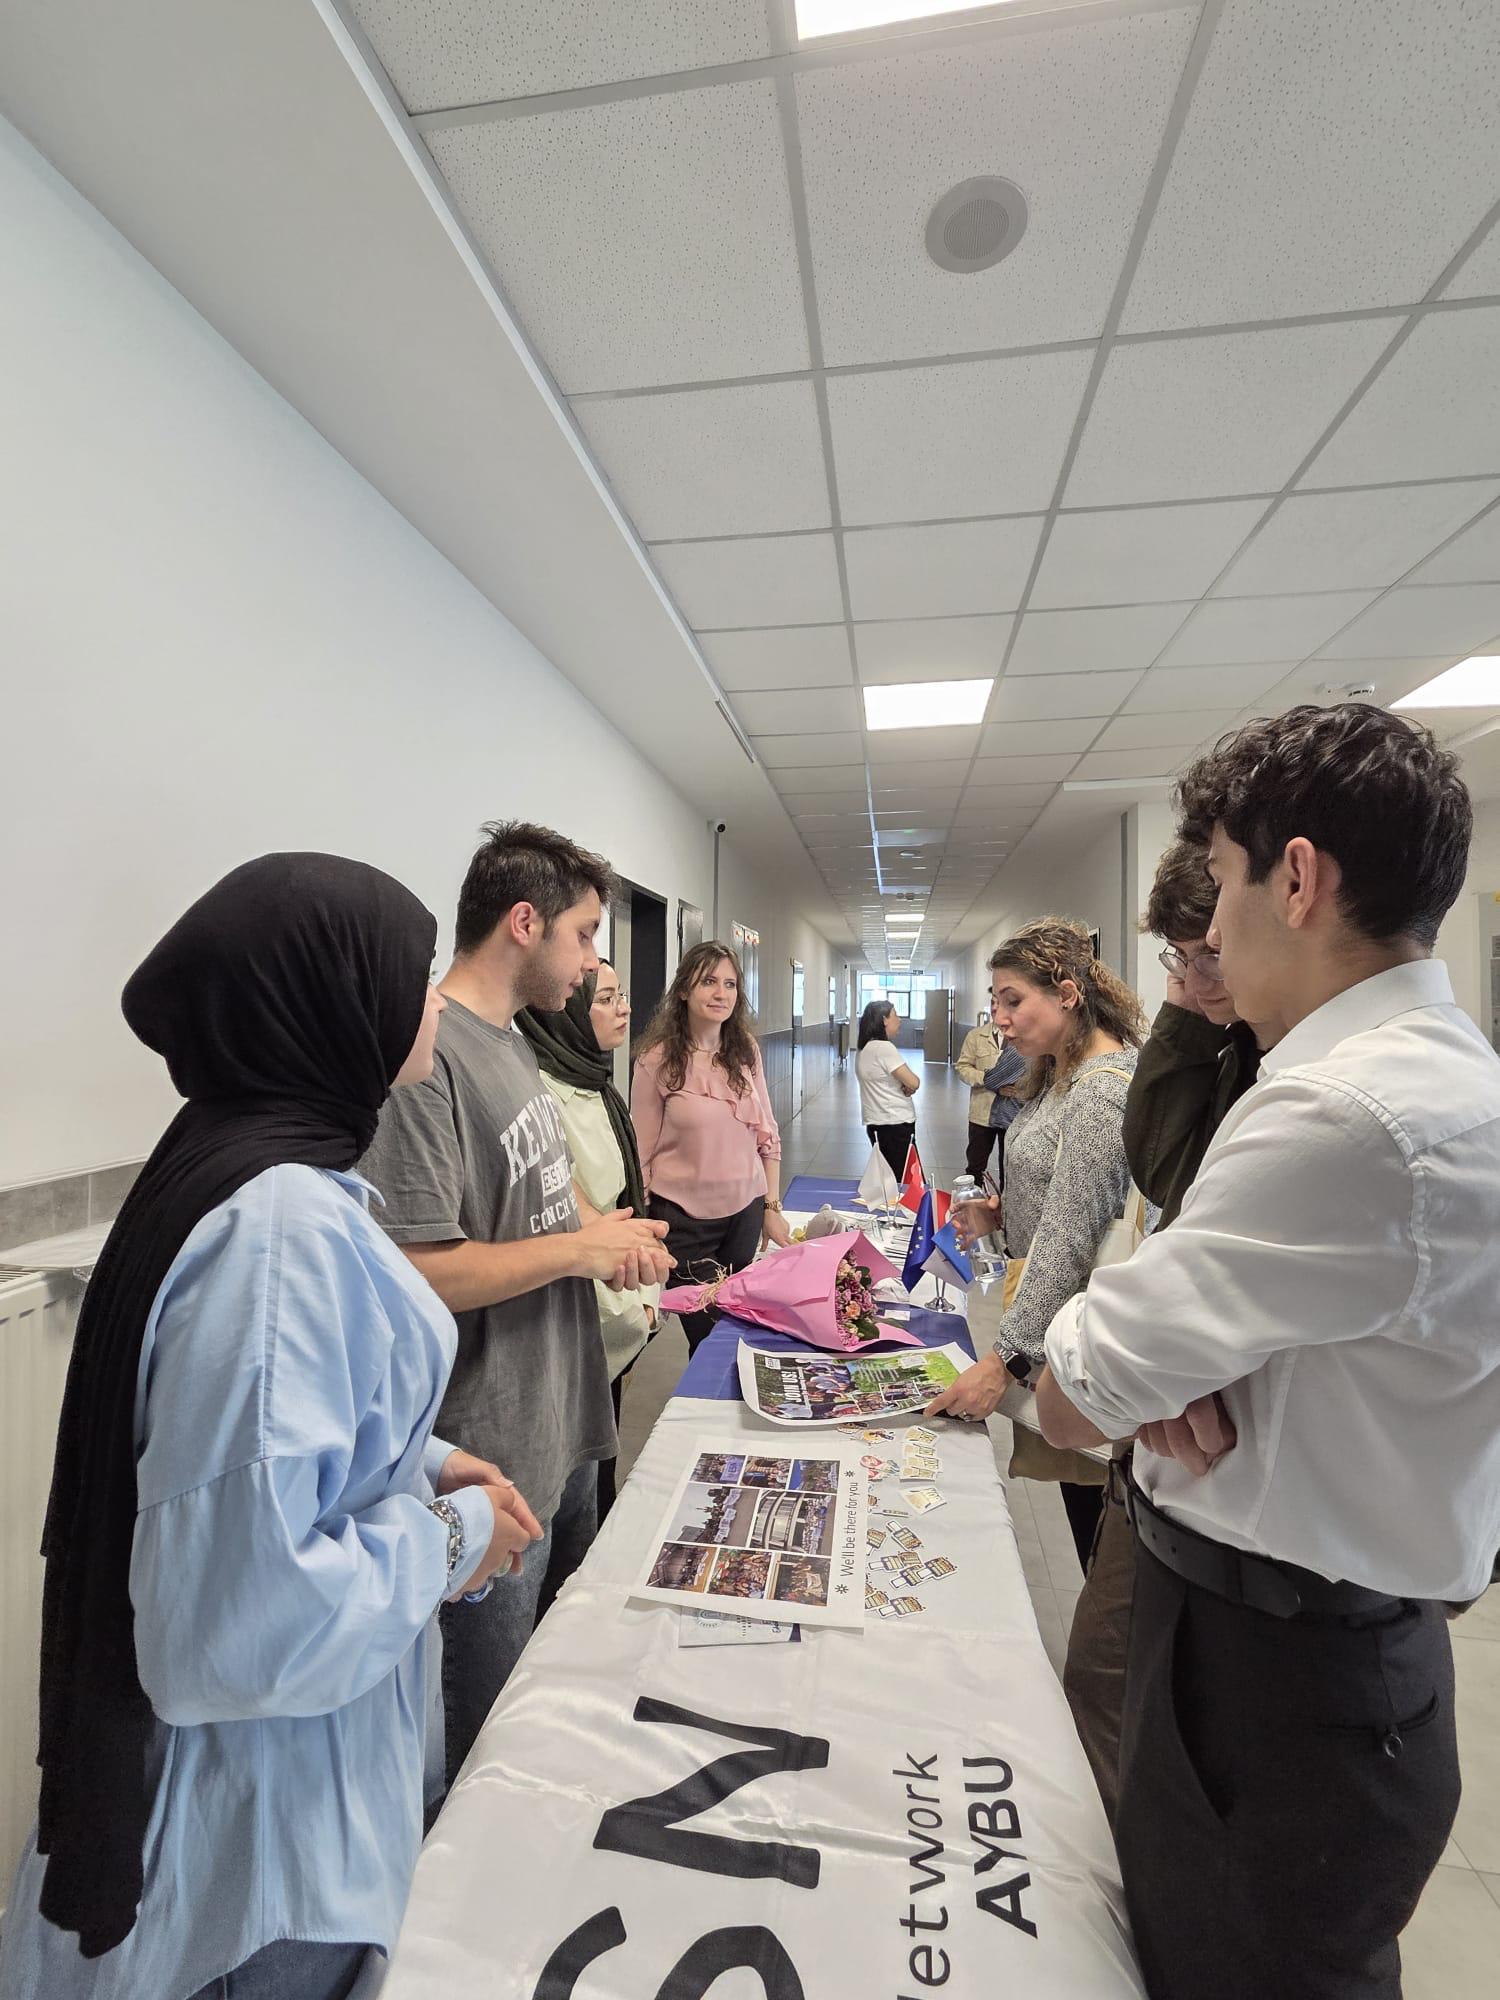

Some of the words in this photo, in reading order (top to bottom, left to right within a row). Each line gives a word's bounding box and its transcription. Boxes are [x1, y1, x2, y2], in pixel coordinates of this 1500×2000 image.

[780, 1371, 798, 1385] US!
[783, 1383, 802, 1402] JOIN
[849, 1482, 860, 1497] you
[845, 1498, 858, 1509] for
[843, 1510, 857, 1535] there
[842, 1536, 856, 1549] be
[839, 1551, 855, 1577] We'll
[962, 1756, 1038, 1939] AYBU
[891, 1752, 951, 2000] etwork
